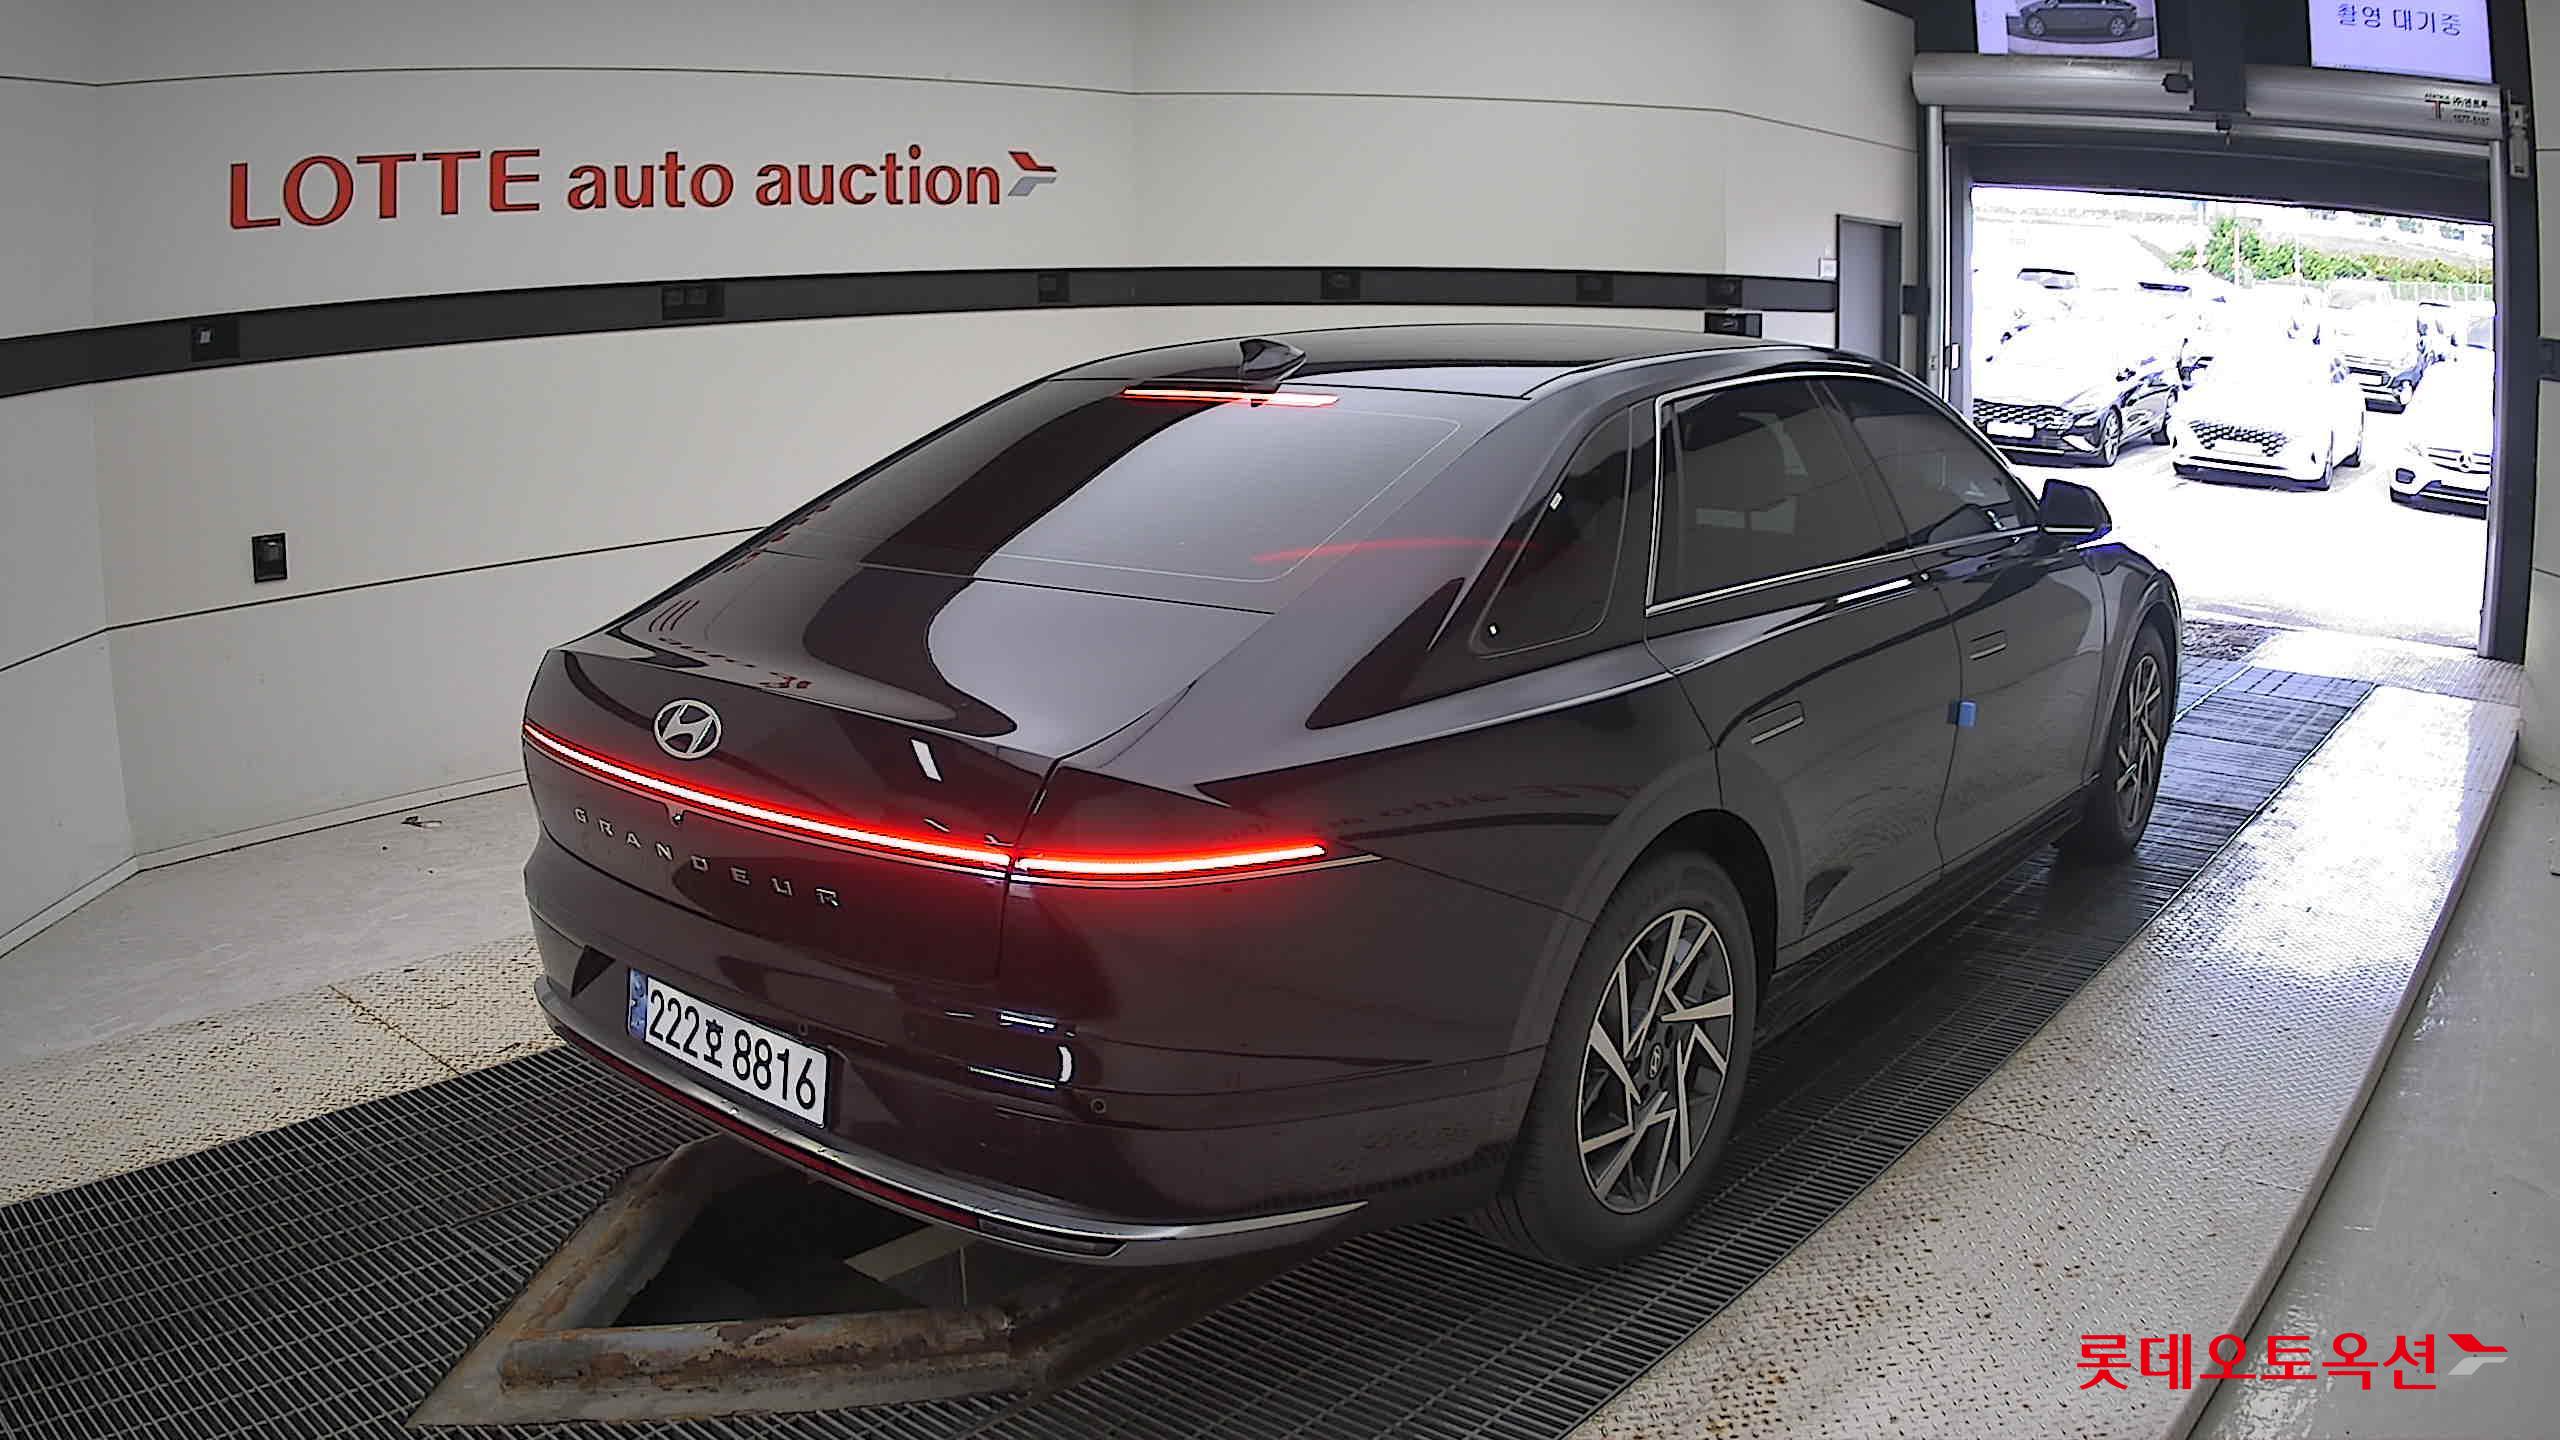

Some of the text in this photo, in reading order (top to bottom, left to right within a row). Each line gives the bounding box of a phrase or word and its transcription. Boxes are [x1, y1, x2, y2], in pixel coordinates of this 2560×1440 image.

[2338, 4, 2462, 36] 촬영 대기중
[230, 143, 1001, 229] LOTTE auto auction
[573, 807, 840, 907] GRANDEUR
[732, 1029, 816, 1110] 8816
